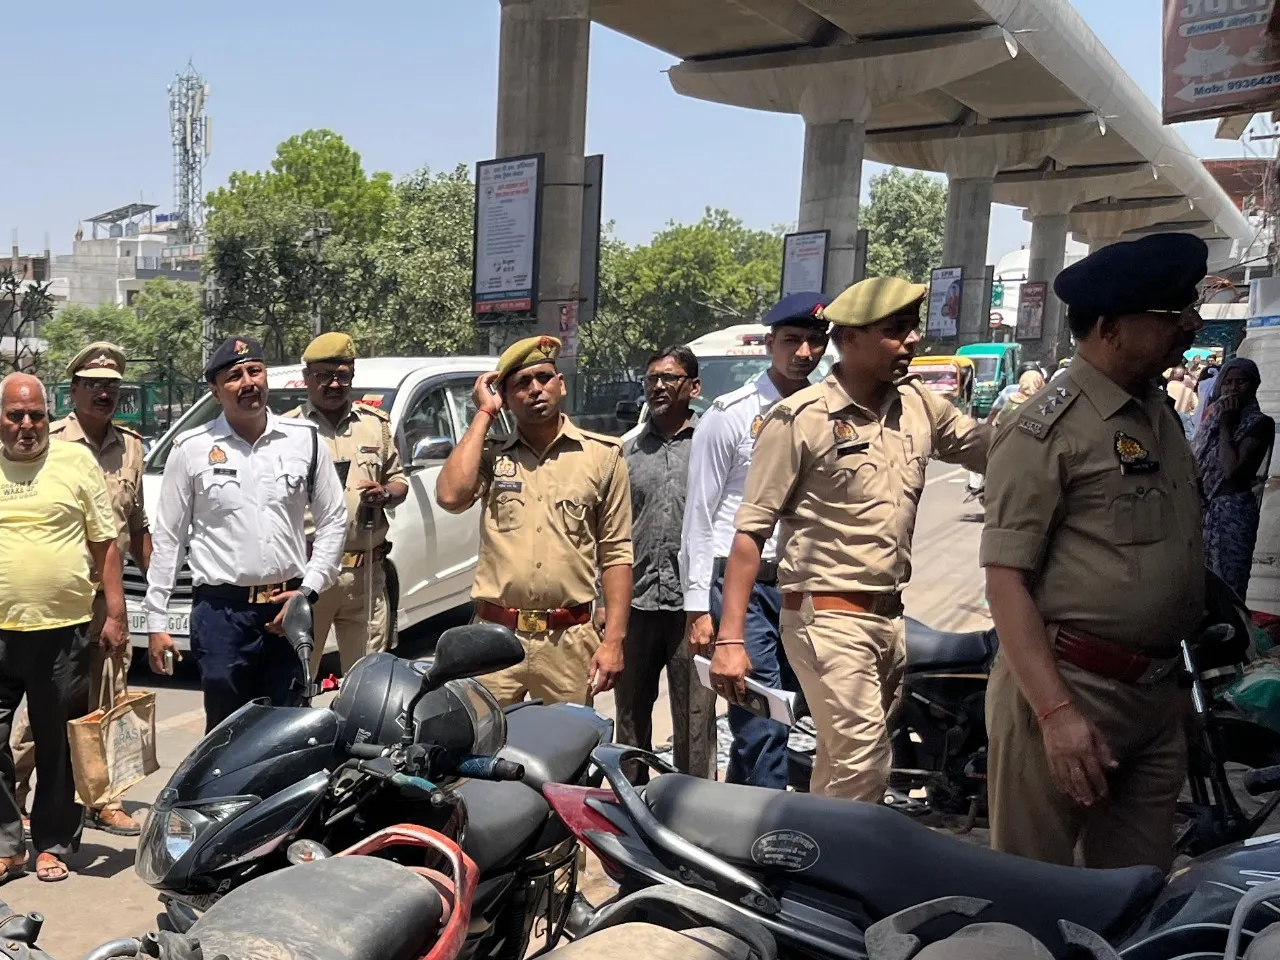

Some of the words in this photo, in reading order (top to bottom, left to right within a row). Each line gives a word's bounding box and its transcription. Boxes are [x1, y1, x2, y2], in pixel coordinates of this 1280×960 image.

[1194, 85, 1223, 97] Mob:
[3, 488, 24, 496] WAKE
[132, 615, 146, 629] UP
